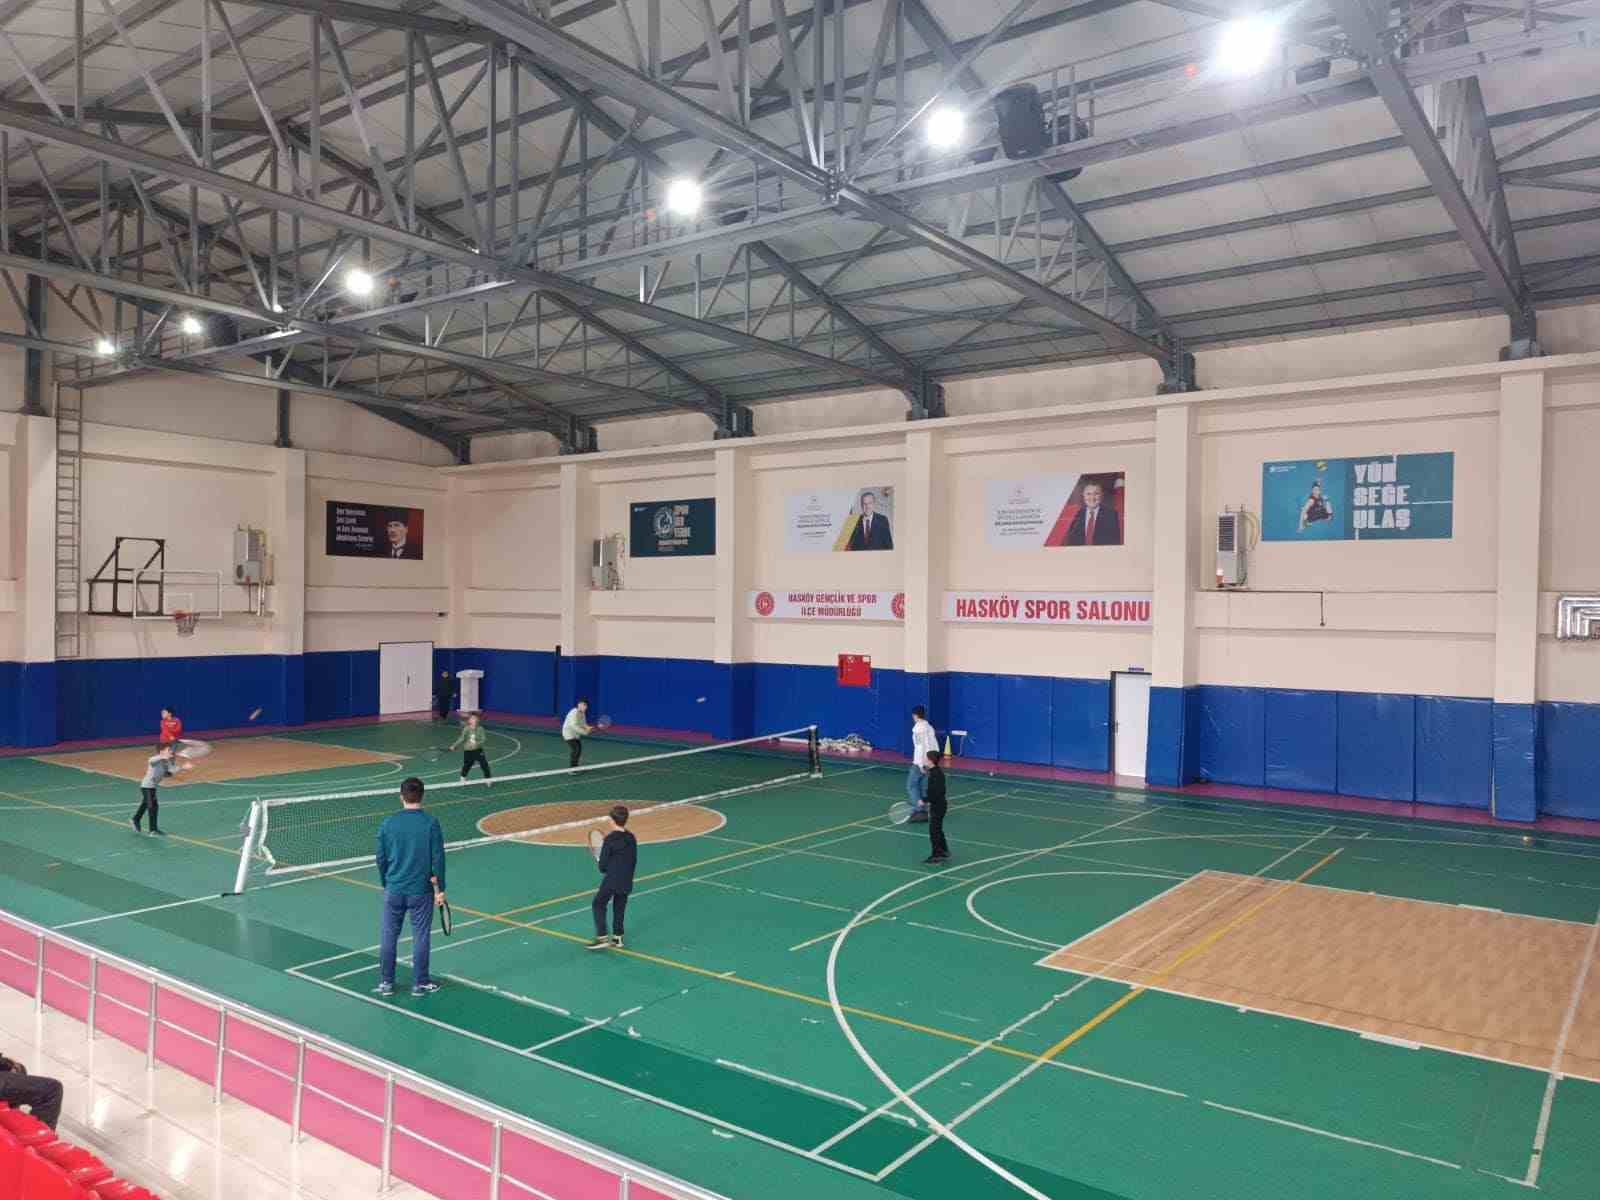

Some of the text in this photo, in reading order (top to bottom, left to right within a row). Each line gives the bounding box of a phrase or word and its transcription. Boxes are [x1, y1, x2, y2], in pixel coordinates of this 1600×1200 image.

[956, 595, 1150, 621] HASKÖY SPOR SALONU
